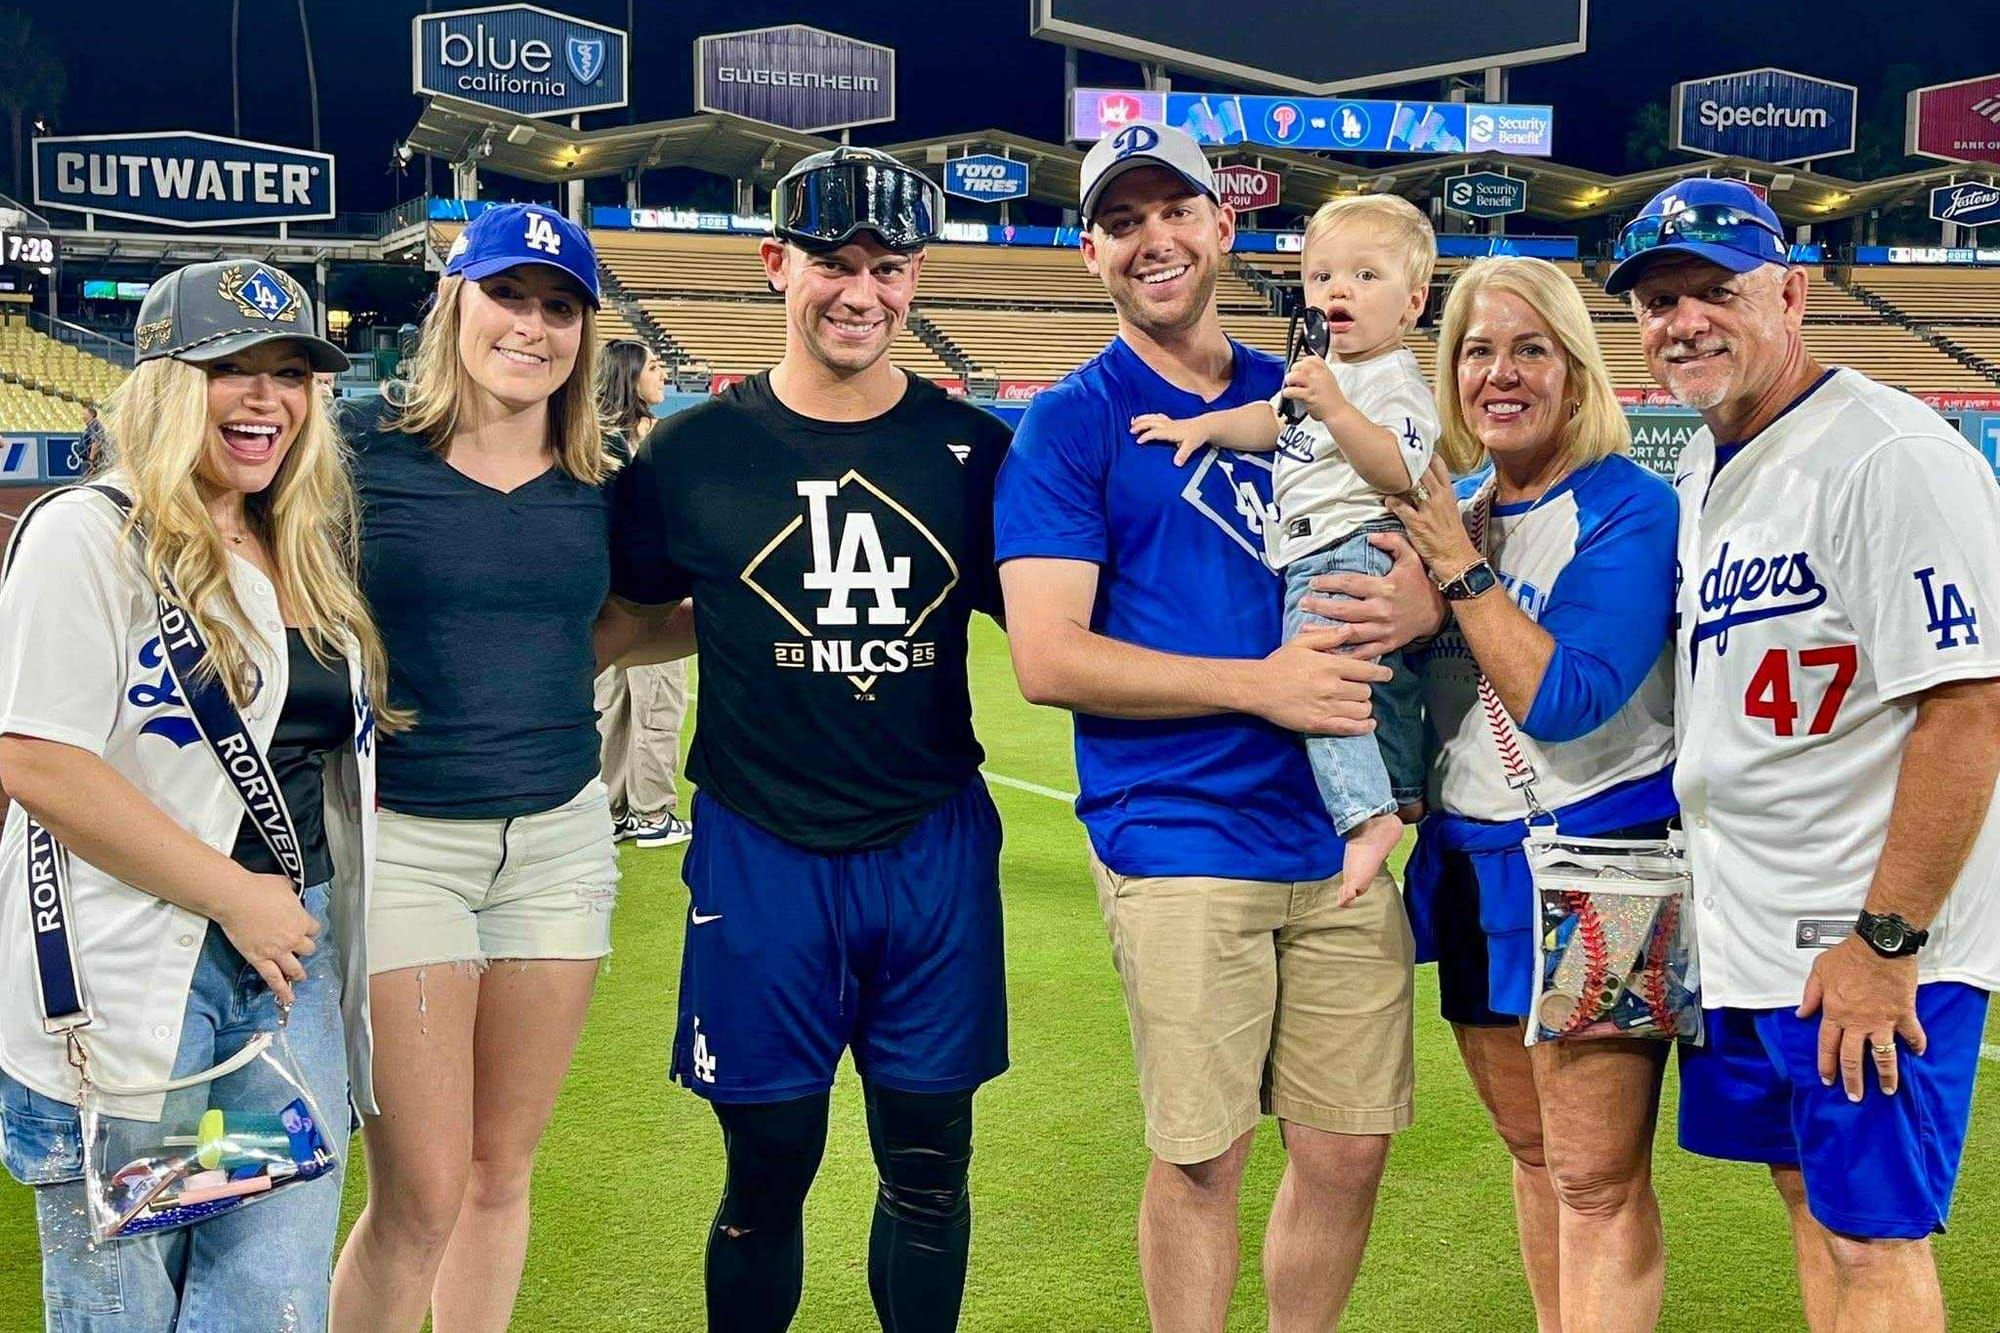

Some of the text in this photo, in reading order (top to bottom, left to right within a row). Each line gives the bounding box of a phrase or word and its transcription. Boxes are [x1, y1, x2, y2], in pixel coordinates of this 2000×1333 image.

[440, 23, 553, 73] blue
[457, 71, 566, 98] california
[717, 66, 878, 92] GUGGENHEIM
[1499, 115, 1547, 132] Security
[1699, 101, 1827, 130] Spectrum
[1499, 130, 1541, 145] Benefit
[1953, 141, 1985, 150] BANK
[56, 151, 313, 206] CUTWATER
[955, 163, 1007, 179] TOYO
[963, 178, 1018, 193] TIRES
[1476, 182, 1519, 198] Security
[1227, 196, 1252, 206] SOJU
[1476, 195, 1513, 207] Benefit
[524, 211, 561, 256] LA
[8, 235, 54, 263] 7:28
[251, 279, 279, 310] LA
[1657, 446, 1666, 458] &
[796, 480, 912, 626] LA
[1698, 541, 1828, 657] dgers
[1913, 566, 1981, 651] LA
[774, 639, 936, 673] 20 NLCS 25
[1744, 644, 1858, 737] 47
[30, 819, 61, 933] RORTV
[693, 1015, 717, 1084] LA
